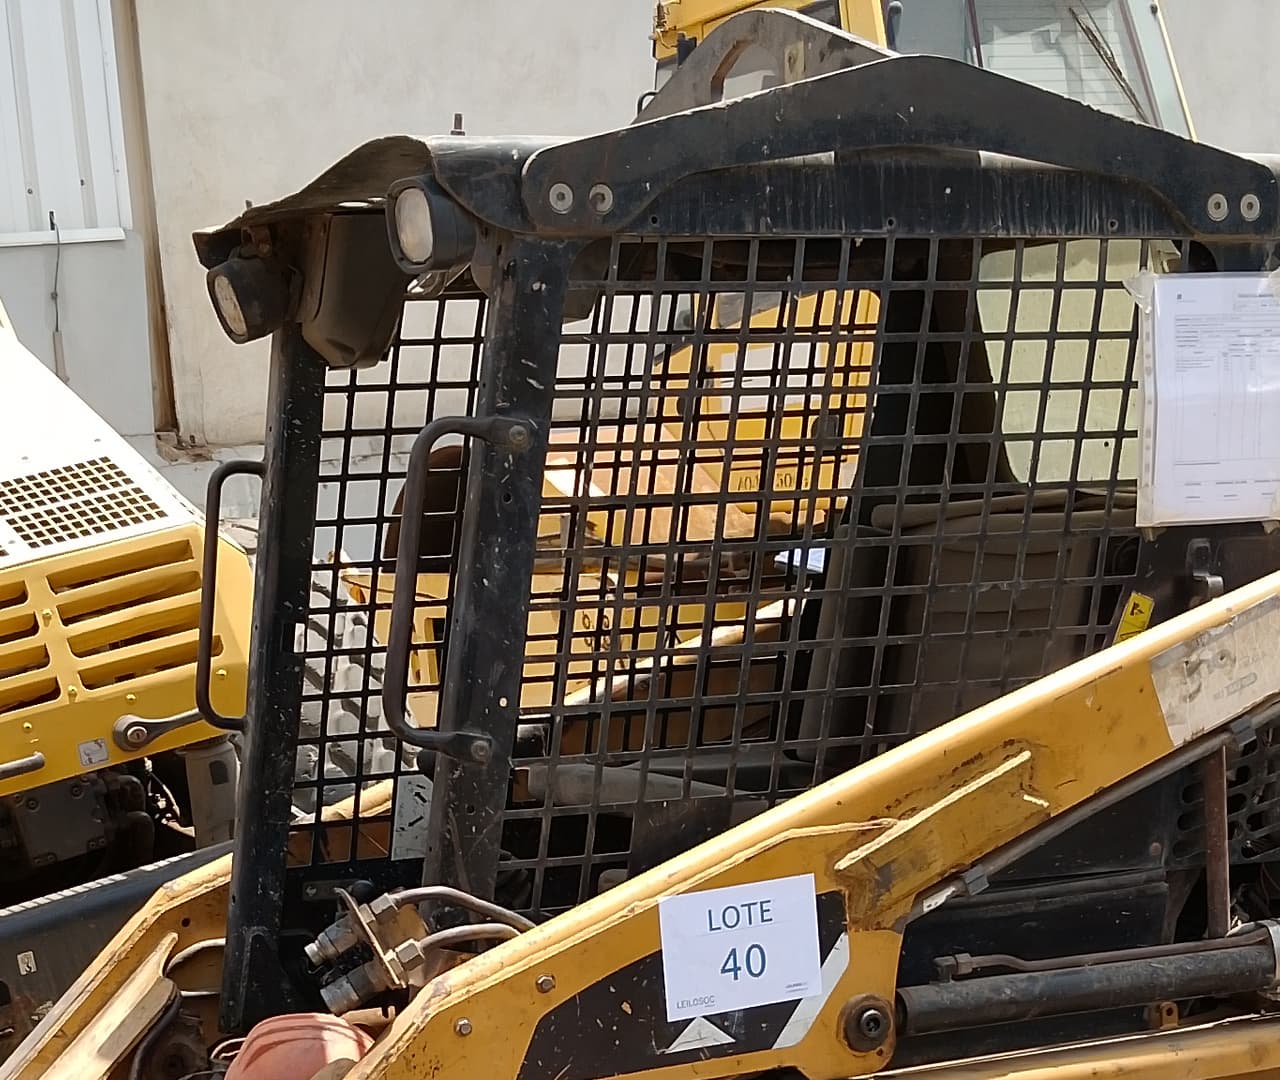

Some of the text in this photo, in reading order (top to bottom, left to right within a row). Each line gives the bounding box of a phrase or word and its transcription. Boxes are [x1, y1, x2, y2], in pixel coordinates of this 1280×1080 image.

[708, 900, 773, 932] LOTE
[720, 943, 766, 981] 40
[676, 995, 716, 1010] LEILOSOC
